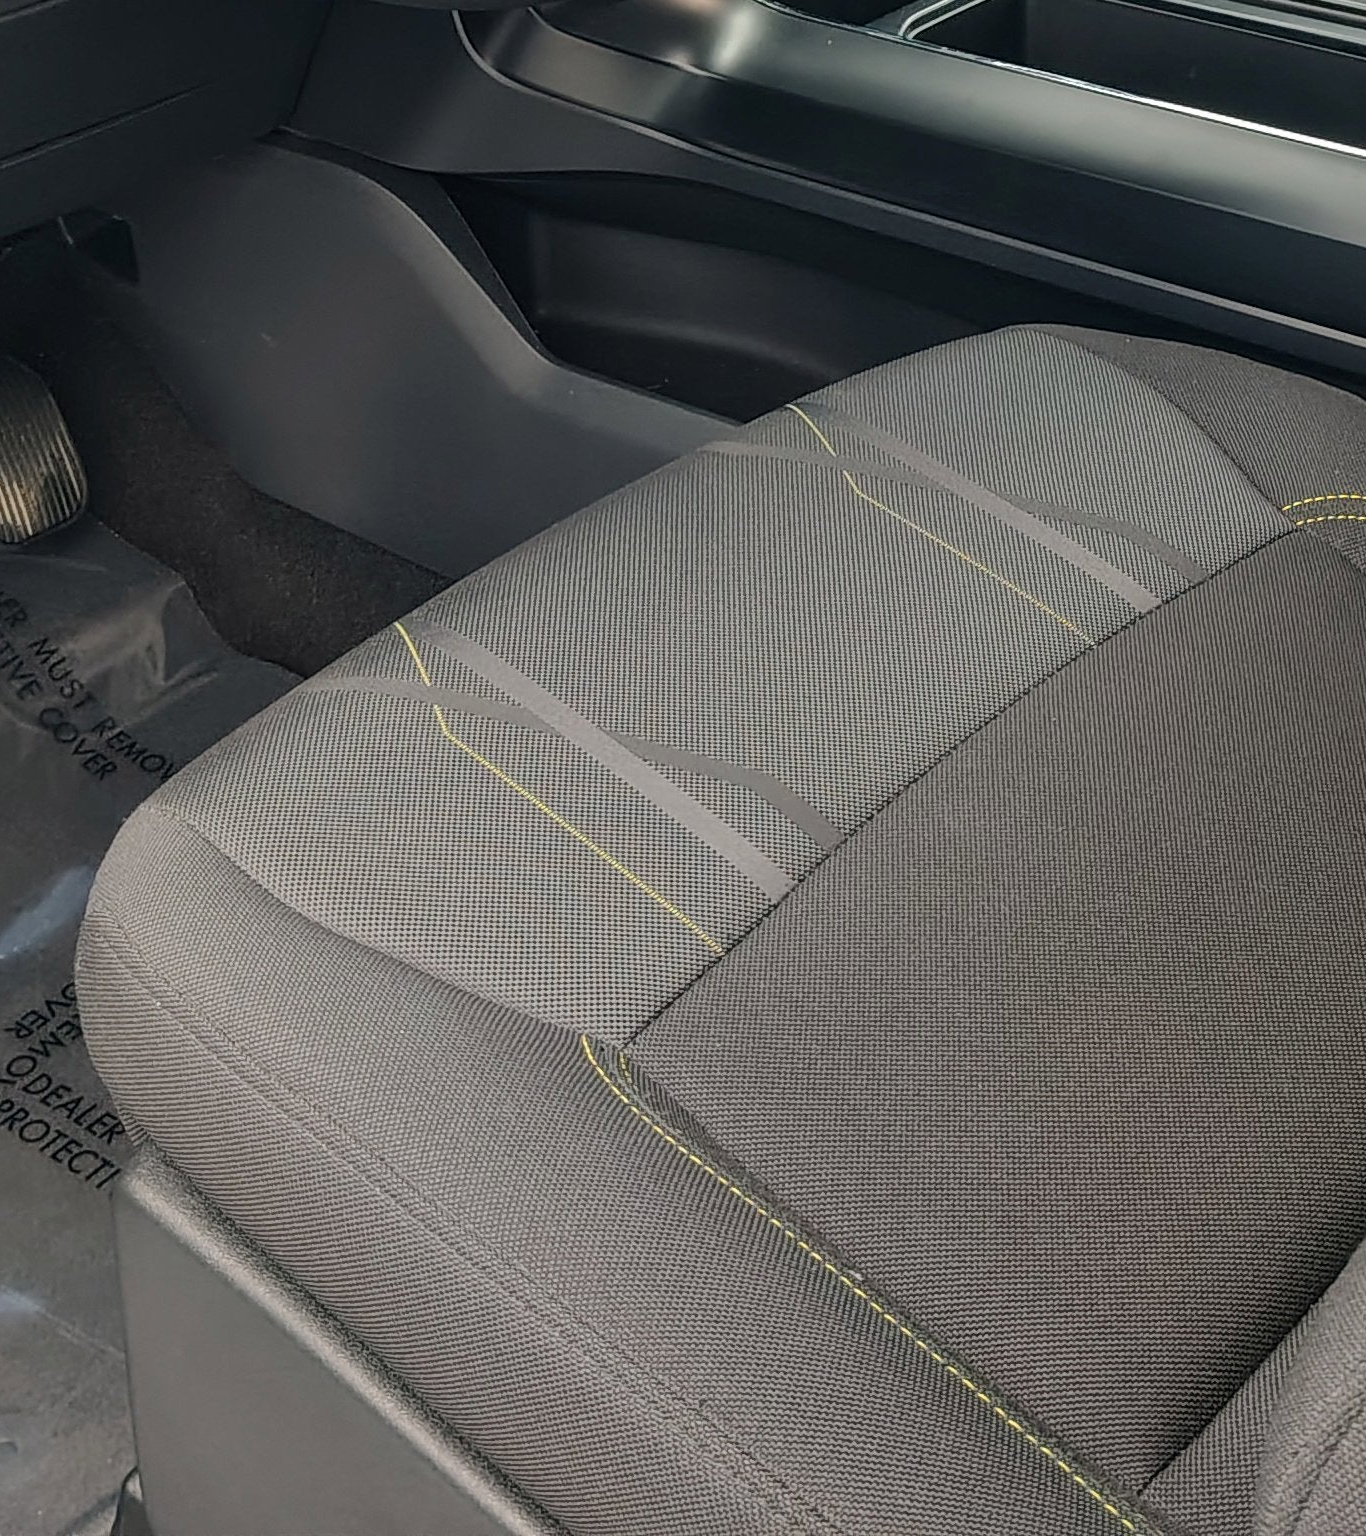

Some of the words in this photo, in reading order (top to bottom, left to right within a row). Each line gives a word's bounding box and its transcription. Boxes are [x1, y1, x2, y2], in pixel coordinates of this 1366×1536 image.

[28, 637, 92, 712] MUST
[39, 707, 119, 783] COVER
[22, 1072, 126, 1146] DEALER
